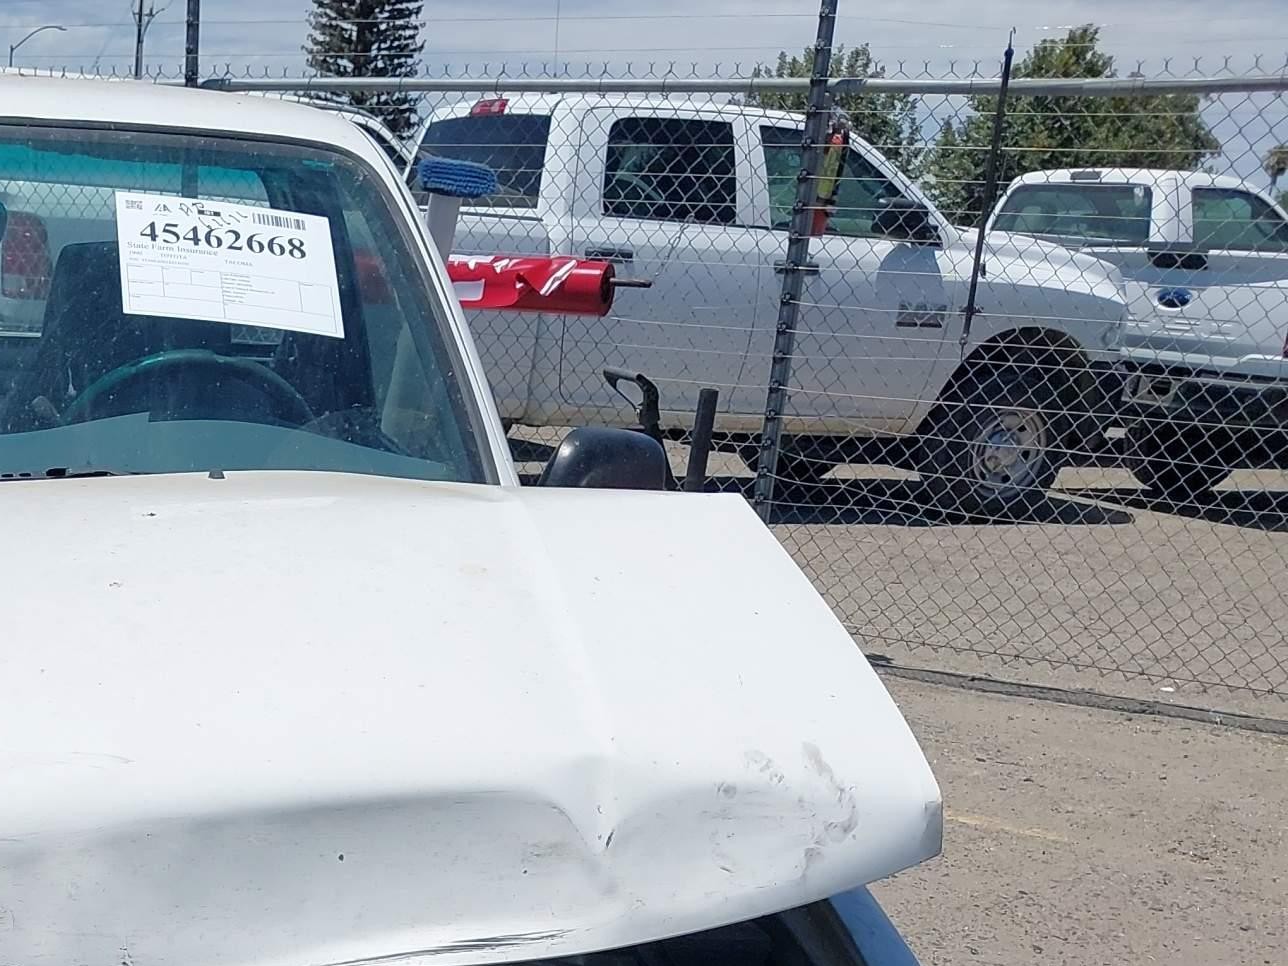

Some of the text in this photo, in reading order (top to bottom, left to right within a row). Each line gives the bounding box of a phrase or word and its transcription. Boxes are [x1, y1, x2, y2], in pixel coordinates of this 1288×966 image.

[127, 241, 150, 250] State
[151, 242, 175, 253] Farm
[176, 246, 219, 257] Insurance
[139, 221, 307, 260] 45462668
